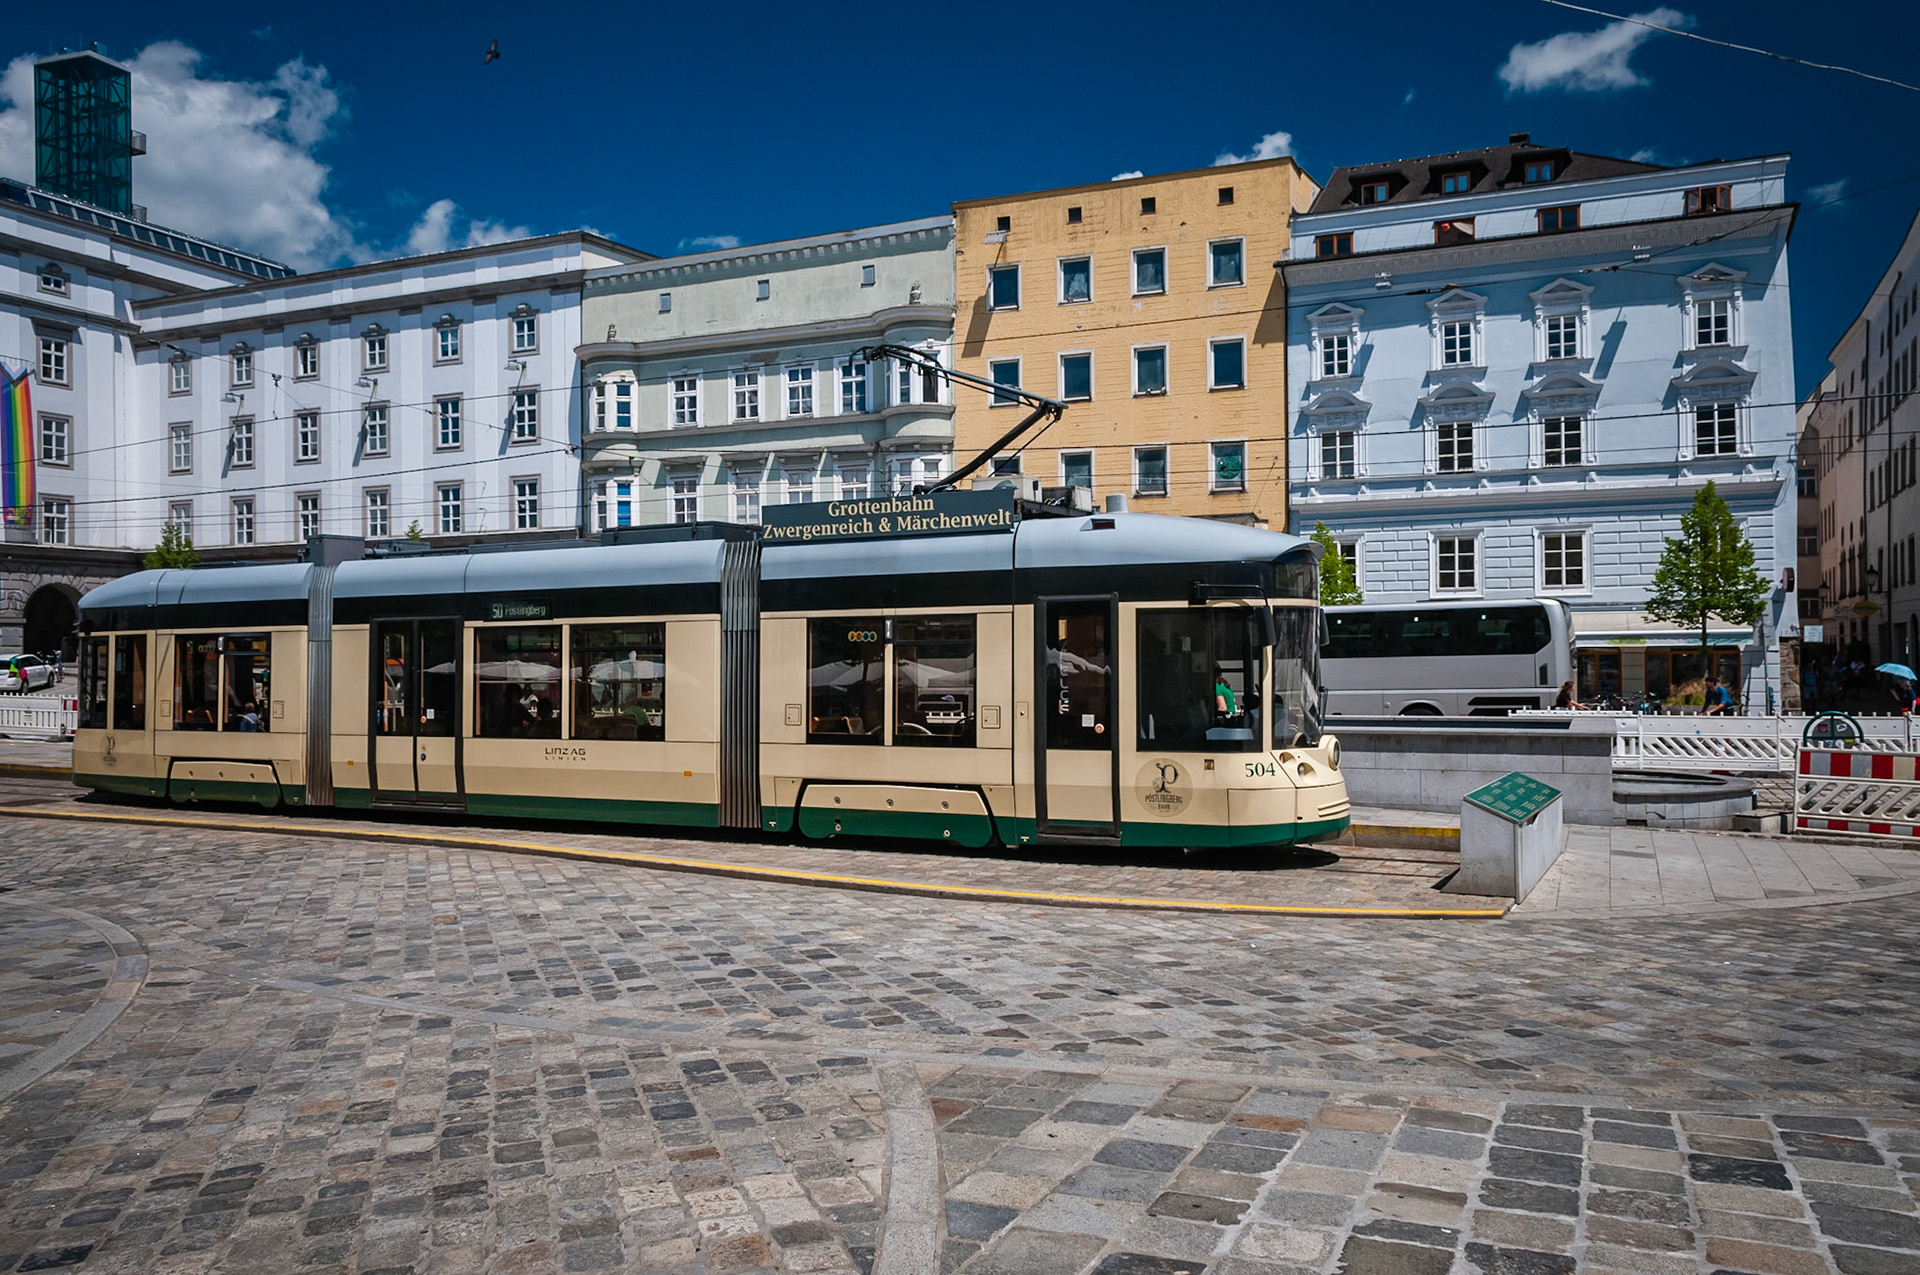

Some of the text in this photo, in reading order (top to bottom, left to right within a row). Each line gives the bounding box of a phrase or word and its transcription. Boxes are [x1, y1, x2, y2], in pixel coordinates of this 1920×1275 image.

[828, 497, 935, 517] Grottenbahn
[763, 509, 1012, 541] Zwergenreich & Märchenwelt
[492, 603, 503, 619] 50
[545, 747, 568, 755] LINZ
[1245, 762, 1276, 778] 504
